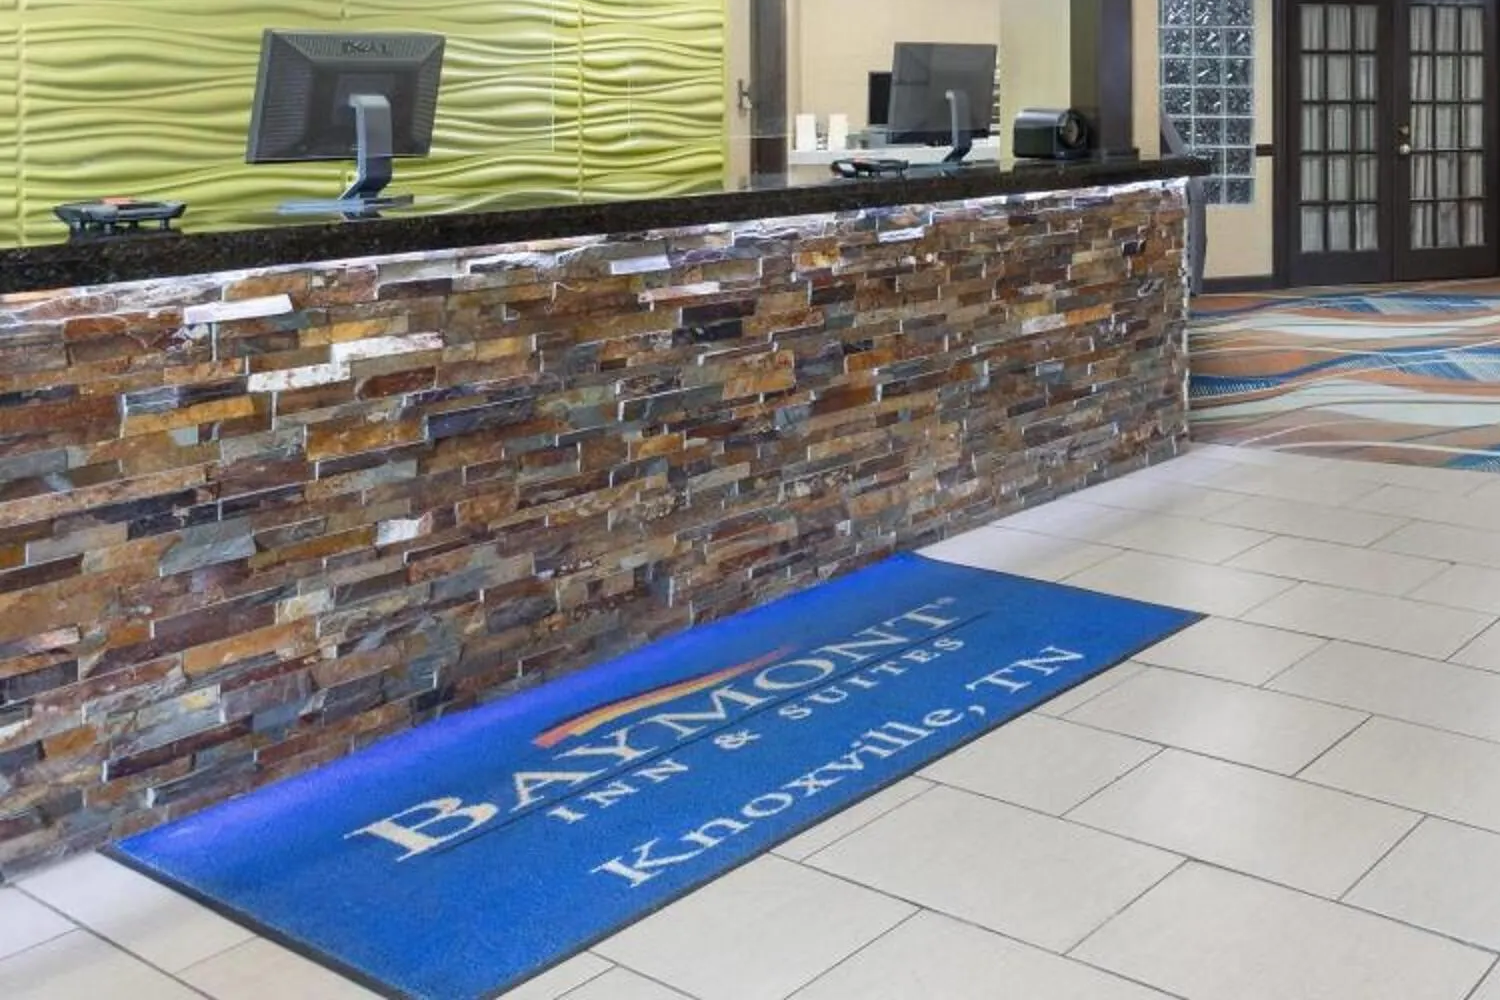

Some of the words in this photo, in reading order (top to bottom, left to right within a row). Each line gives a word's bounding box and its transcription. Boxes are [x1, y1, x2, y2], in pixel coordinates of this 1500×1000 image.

[342, 601, 960, 863] BAYMONT
[547, 758, 689, 824] INN
[713, 728, 761, 751] &
[778, 636, 965, 721] SUITES
[590, 704, 986, 889] Knoxville,
[965, 646, 1084, 694] TN
